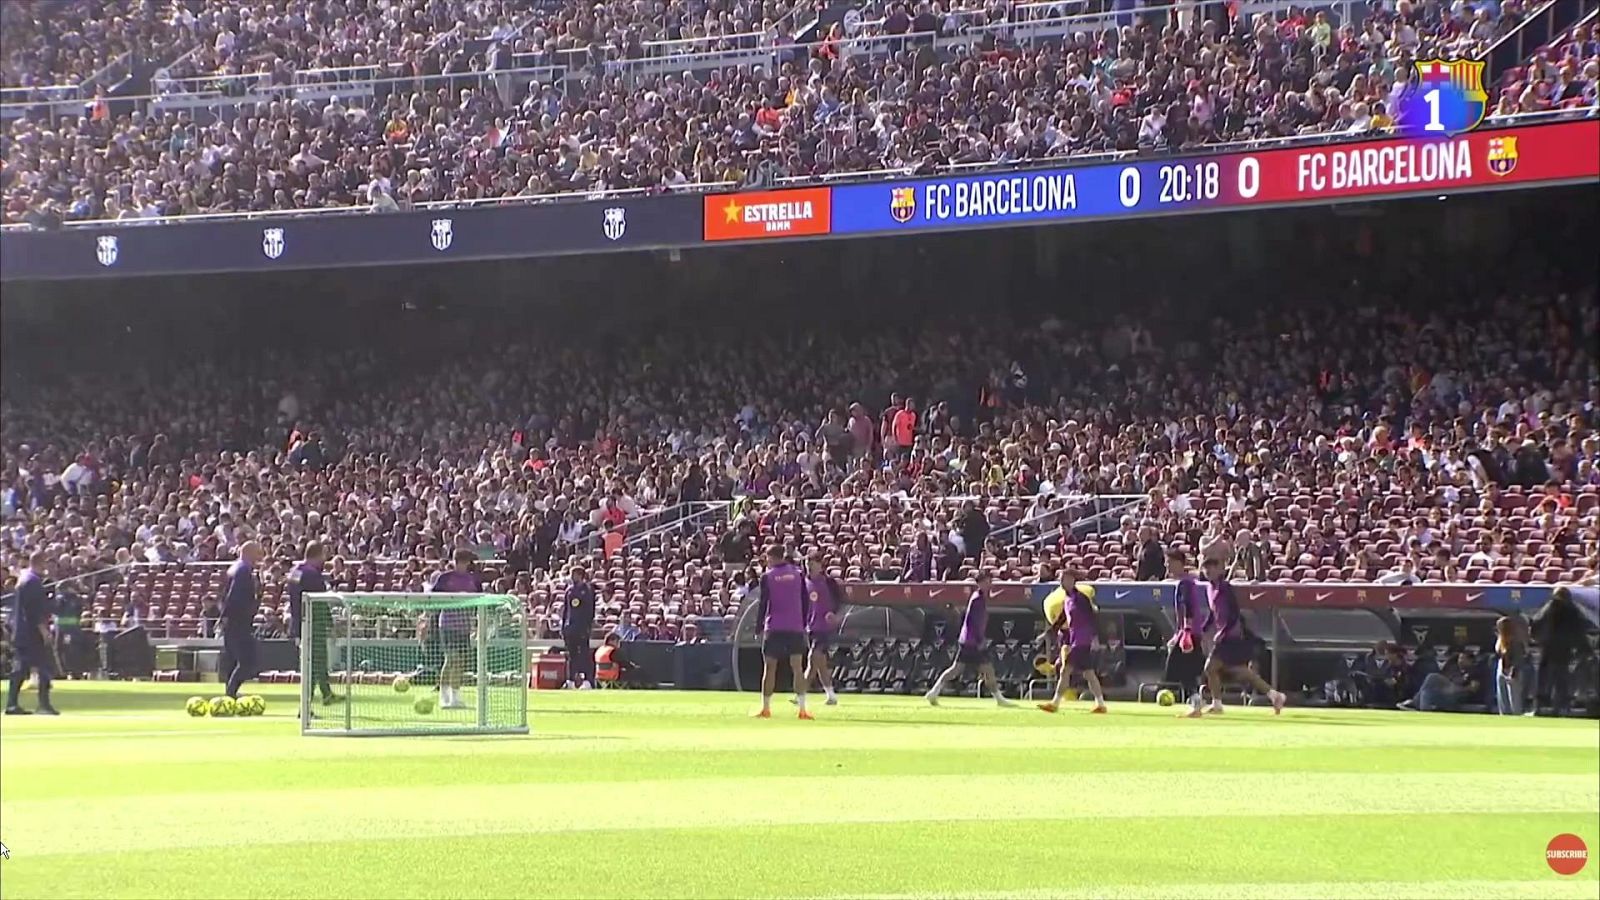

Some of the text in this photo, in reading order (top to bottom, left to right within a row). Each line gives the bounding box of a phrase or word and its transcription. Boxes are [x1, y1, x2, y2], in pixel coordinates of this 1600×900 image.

[925, 140, 1472, 220] FC BARCELONA 0 20:18 0 FC BARCELONA
[744, 201, 813, 222] ESTRELLA
[765, 221, 791, 232] DAMM
